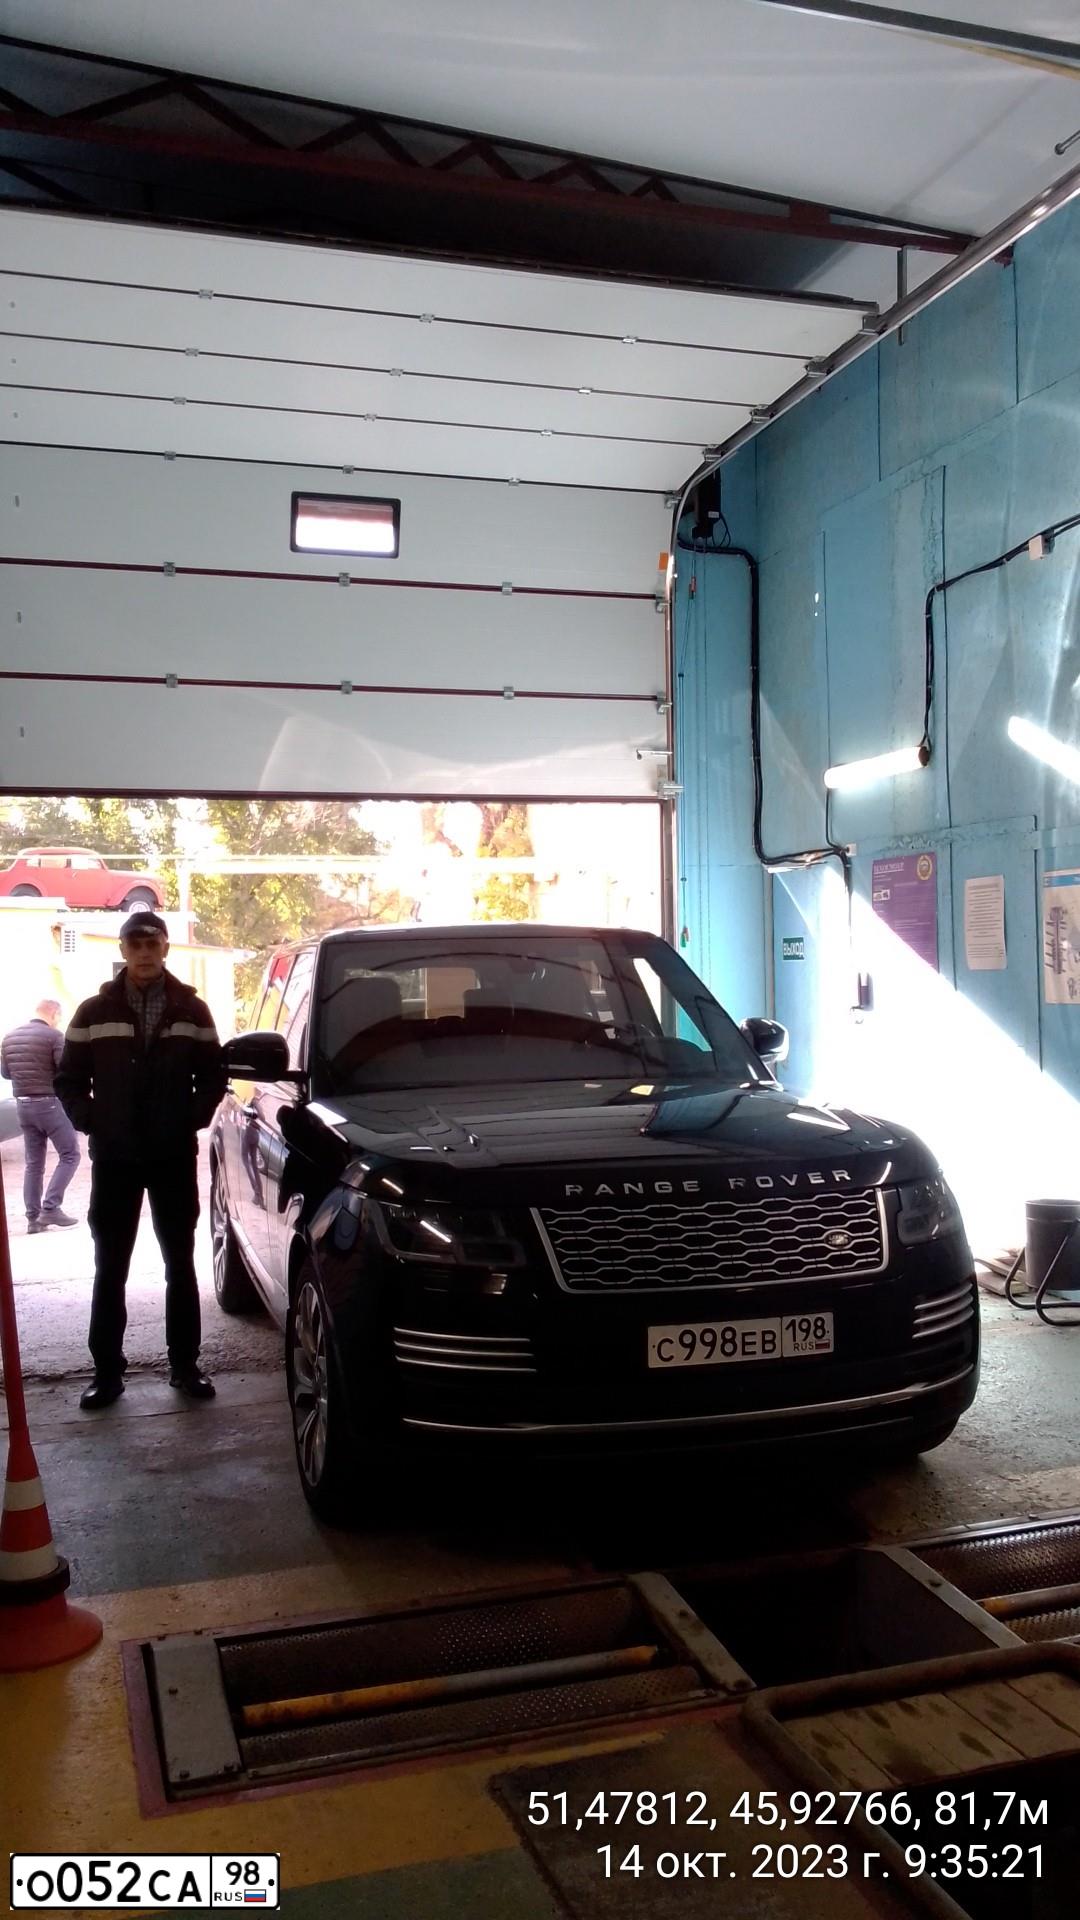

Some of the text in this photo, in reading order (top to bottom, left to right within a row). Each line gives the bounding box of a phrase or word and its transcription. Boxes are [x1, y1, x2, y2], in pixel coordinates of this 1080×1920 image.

[564, 1169, 850, 1197] RANGE ROVER
[656, 1317, 826, 1362] С998ЕВ 198
[793, 1342, 814, 1352] RUS
